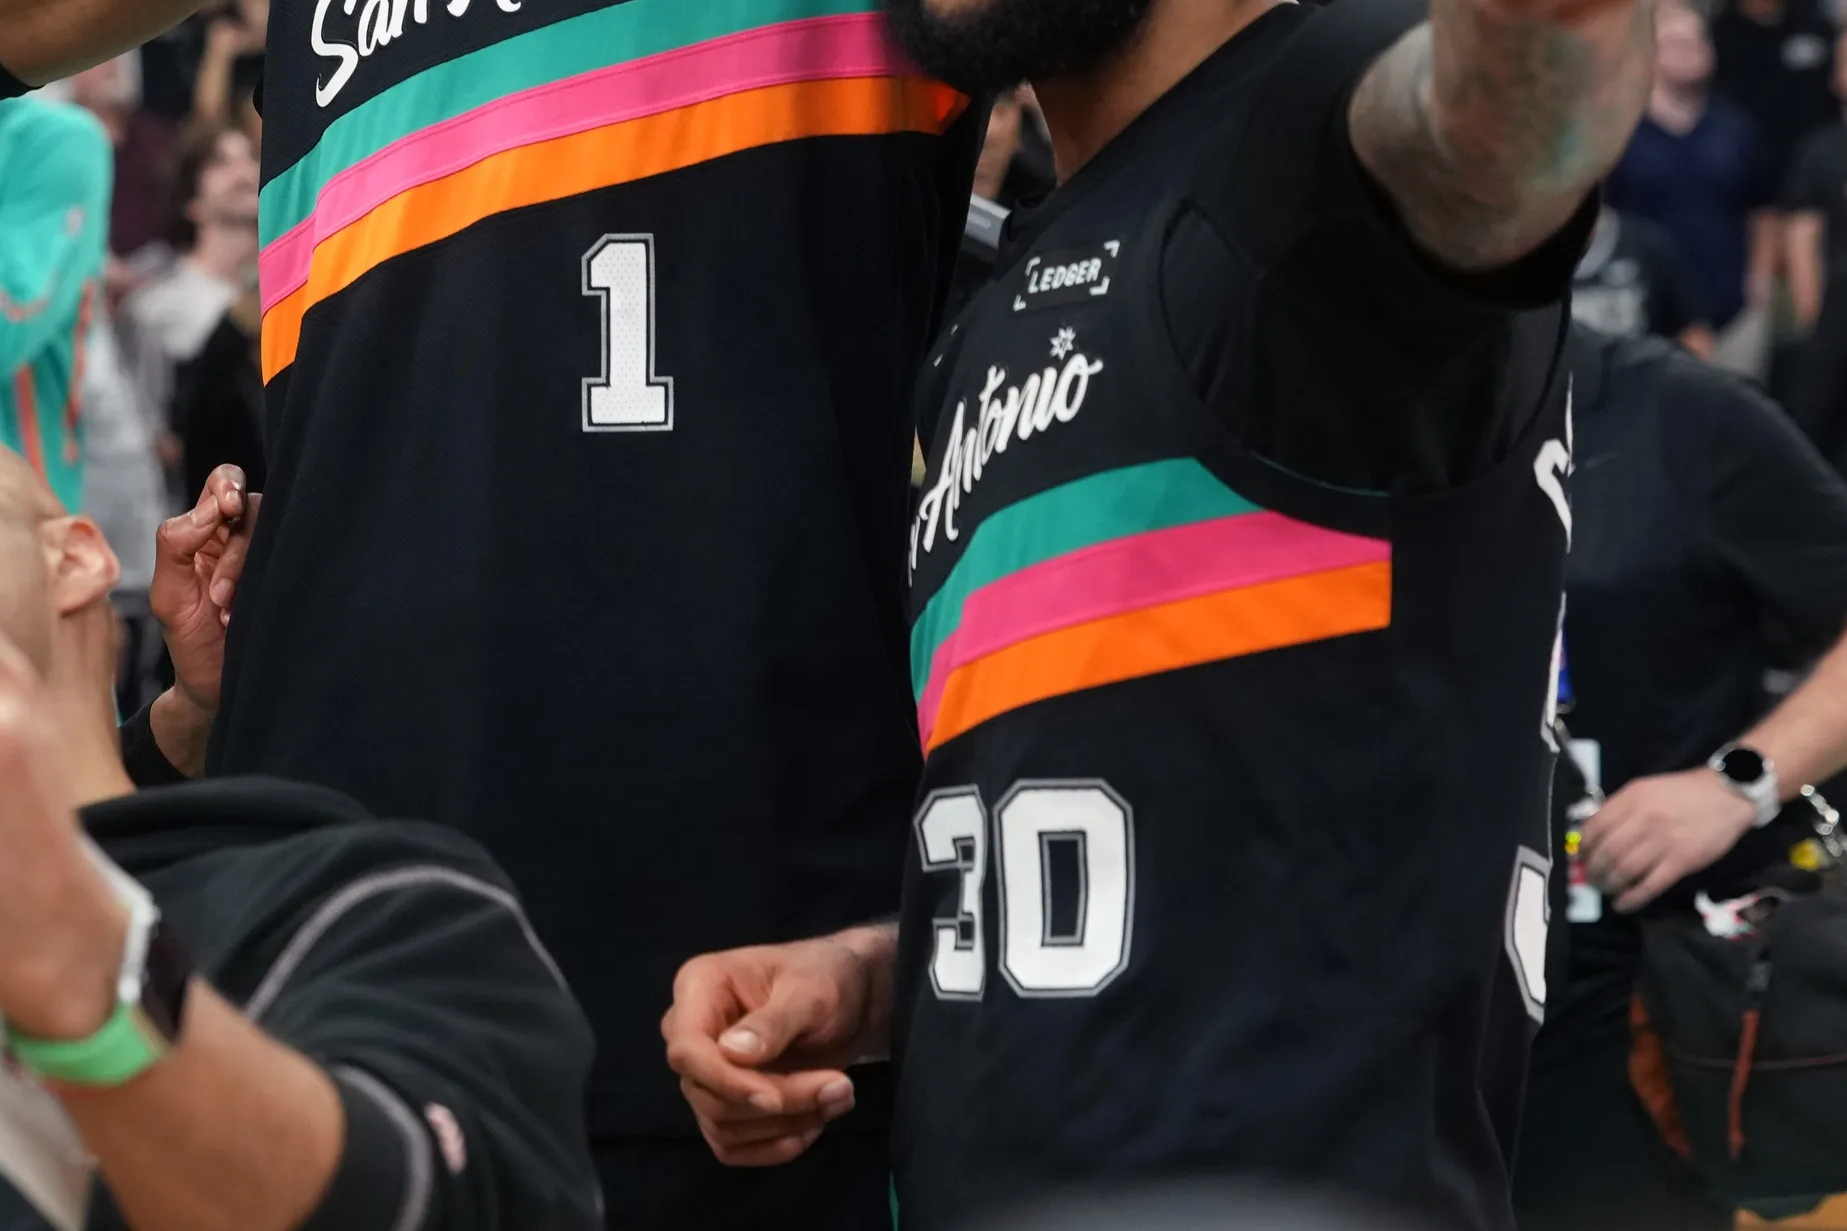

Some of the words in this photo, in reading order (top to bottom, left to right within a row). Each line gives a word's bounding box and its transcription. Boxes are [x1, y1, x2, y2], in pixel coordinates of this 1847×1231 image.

[581, 232, 675, 432] 1
[1027, 257, 1103, 294] LEDGER
[918, 326, 1104, 554] Antonio
[914, 778, 1135, 1003] 30
